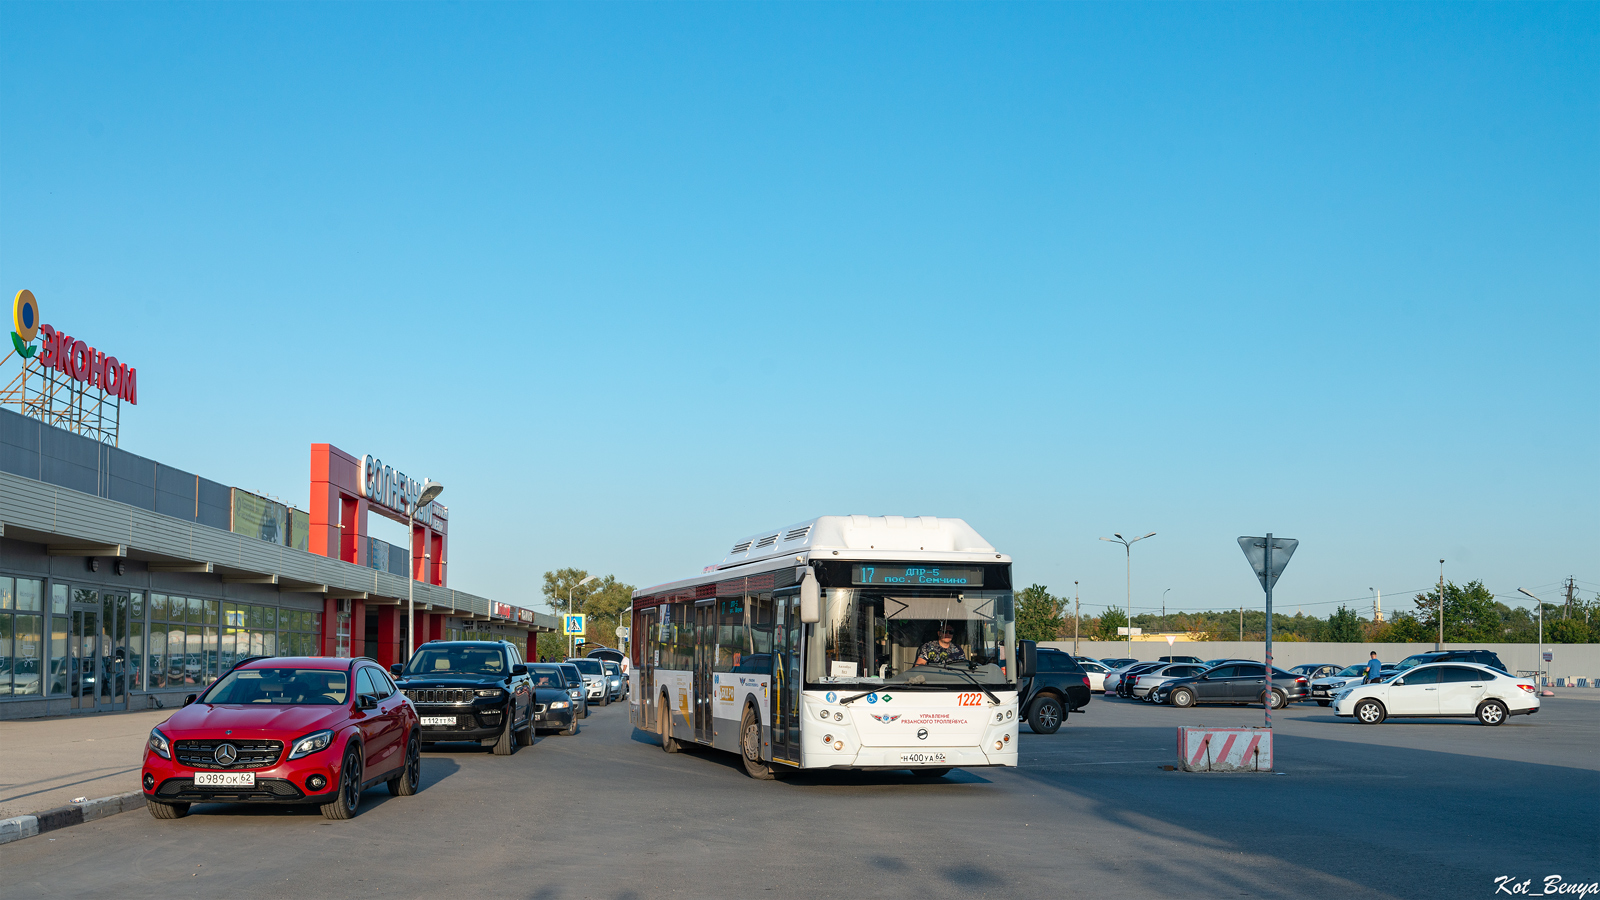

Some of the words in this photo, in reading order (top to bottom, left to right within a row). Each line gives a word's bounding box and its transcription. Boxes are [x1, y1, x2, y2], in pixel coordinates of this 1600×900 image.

[40, 324, 137, 405] ЭКОНОМ
[861, 567, 875, 583] 17
[905, 568, 940, 577] ДПР-5
[918, 575, 967, 584] Семчино
[957, 692, 982, 707] 1222
